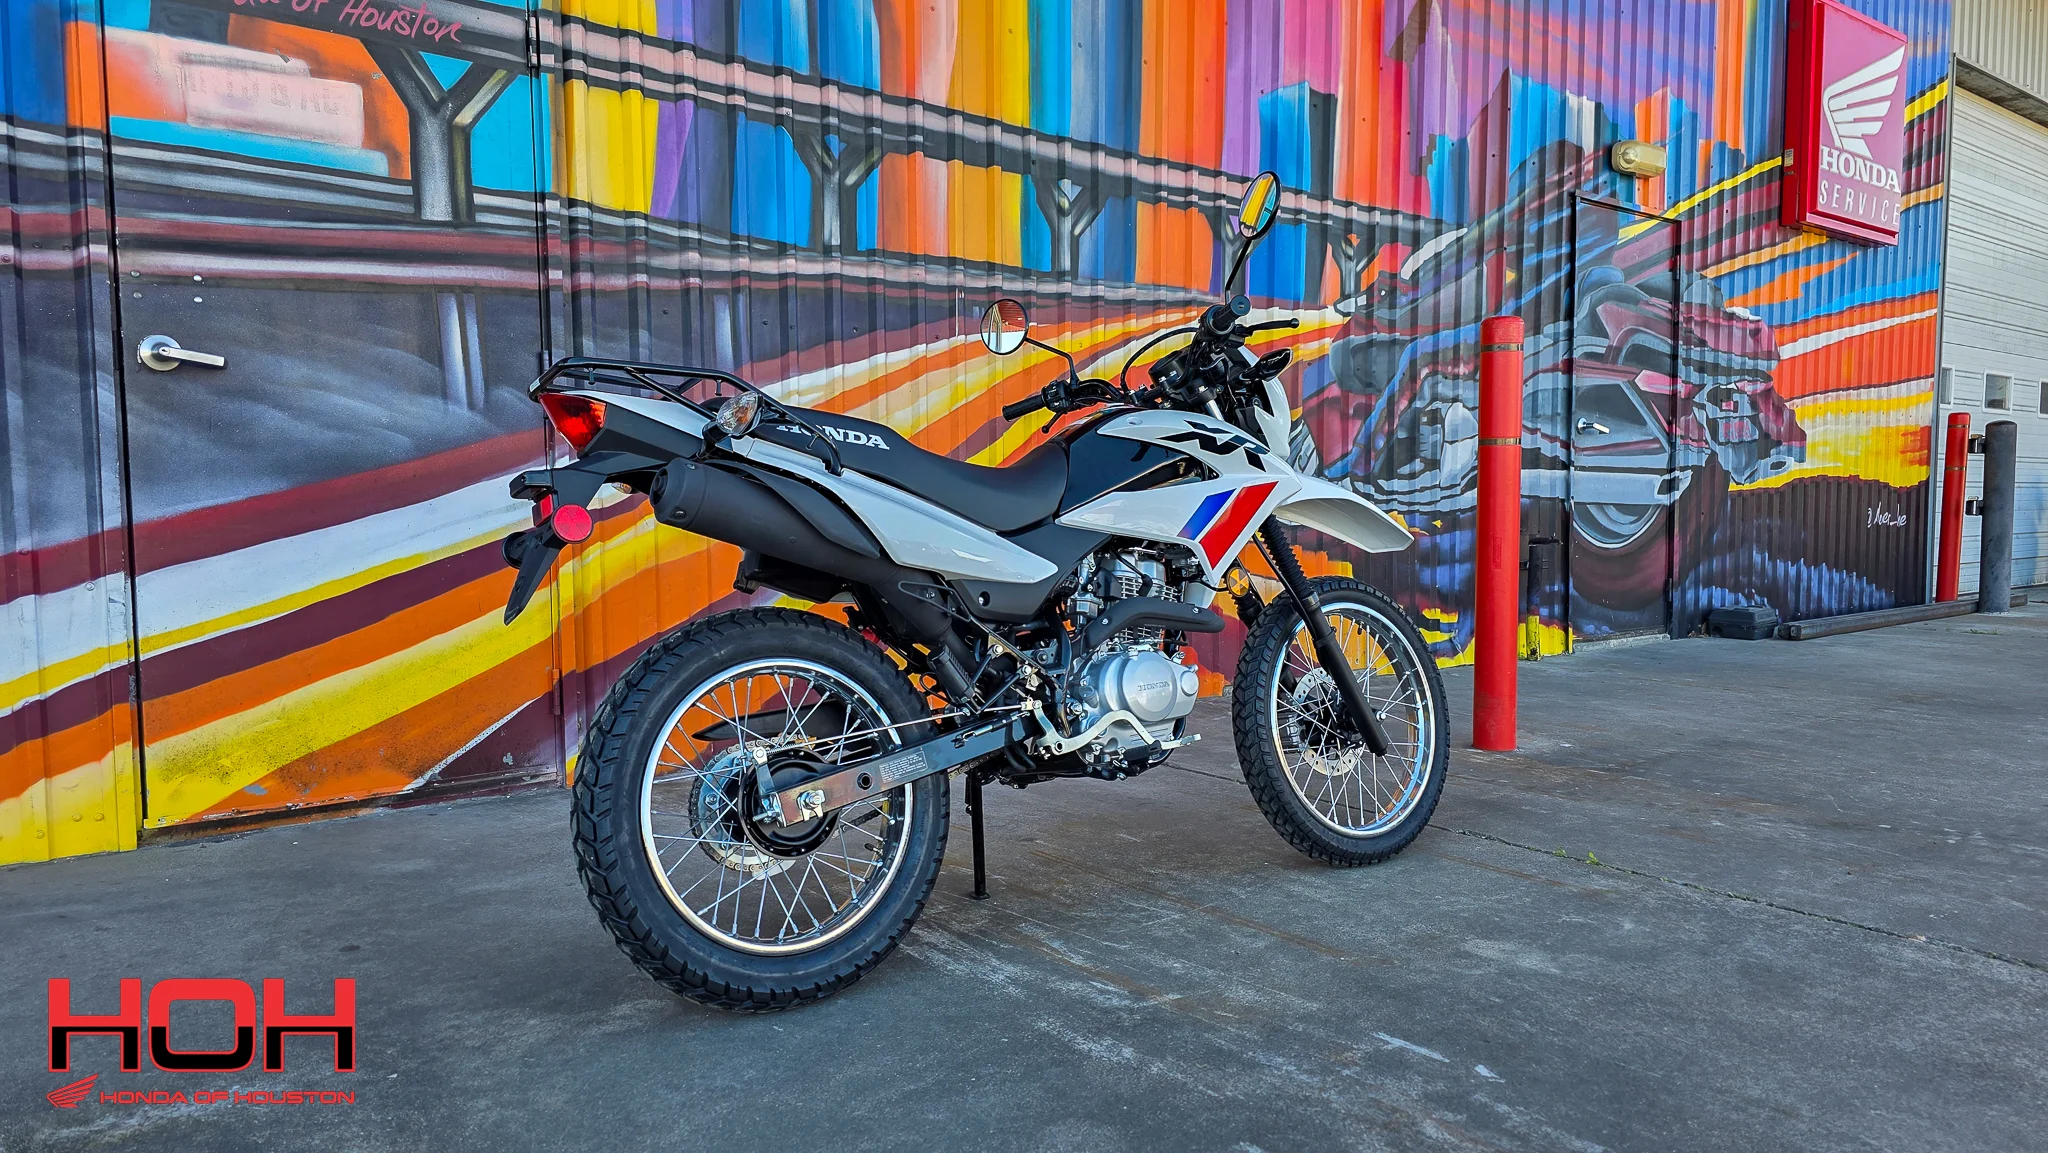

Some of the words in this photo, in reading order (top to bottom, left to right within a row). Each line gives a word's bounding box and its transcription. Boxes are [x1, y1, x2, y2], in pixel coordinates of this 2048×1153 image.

[338, 0, 462, 43] Houston
[1820, 145, 1901, 194] HONDA
[1819, 179, 1901, 226] SERVICE
[1137, 680, 1170, 691] HONDA
